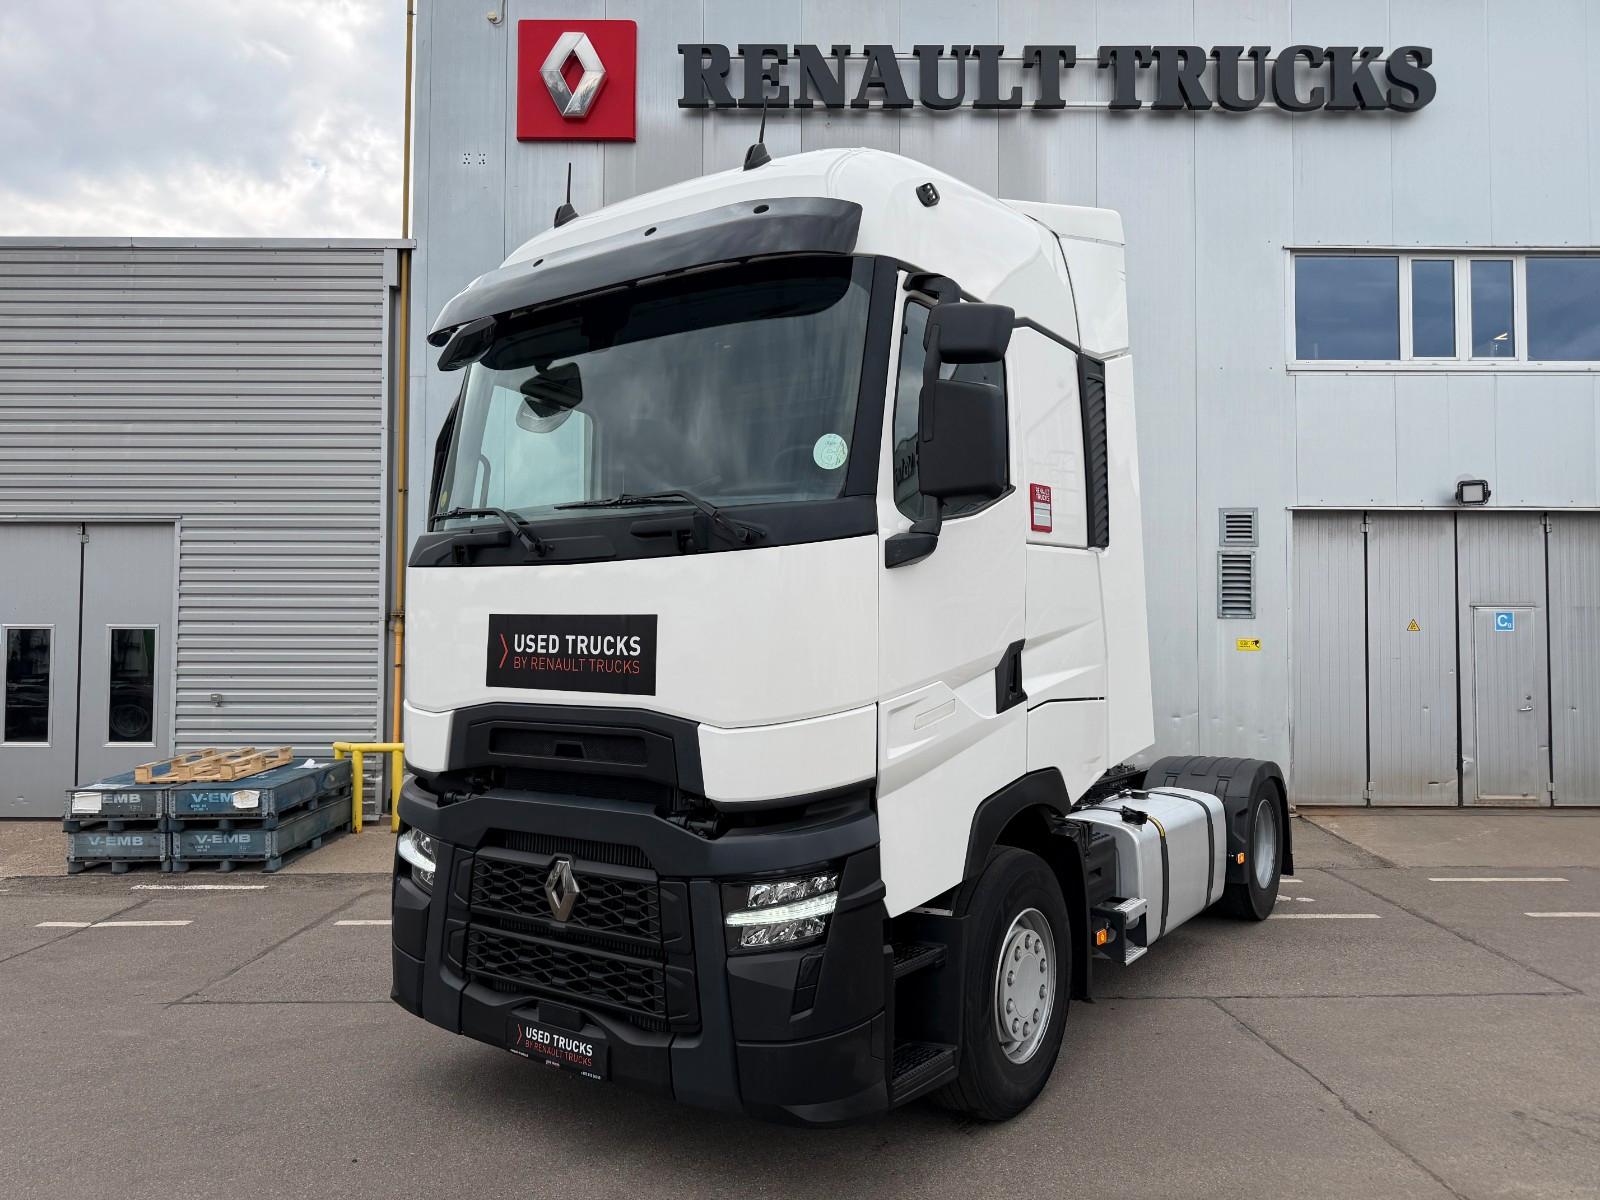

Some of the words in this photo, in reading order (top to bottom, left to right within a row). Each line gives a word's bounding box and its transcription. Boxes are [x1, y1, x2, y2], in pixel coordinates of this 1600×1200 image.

[678, 43, 1076, 110] RENAULT
[1097, 44, 1437, 113] TRUCKS
[514, 633, 560, 654] USED
[565, 635, 641, 656] TRUCKS
[513, 656, 528, 669] BY
[530, 656, 586, 672] RENAULT
[588, 658, 640, 674] TRUCKS
[191, 792, 233, 803] V-EM
[88, 836, 144, 846] V-EMB
[195, 833, 251, 844] V-EMB
[525, 1026, 551, 1045] USED
[553, 1034, 593, 1057] TRUCKS
[525, 1040, 533, 1048] BY
[534, 1042, 563, 1058] RENAULT
[564, 1051, 592, 1067] TRUCKS
